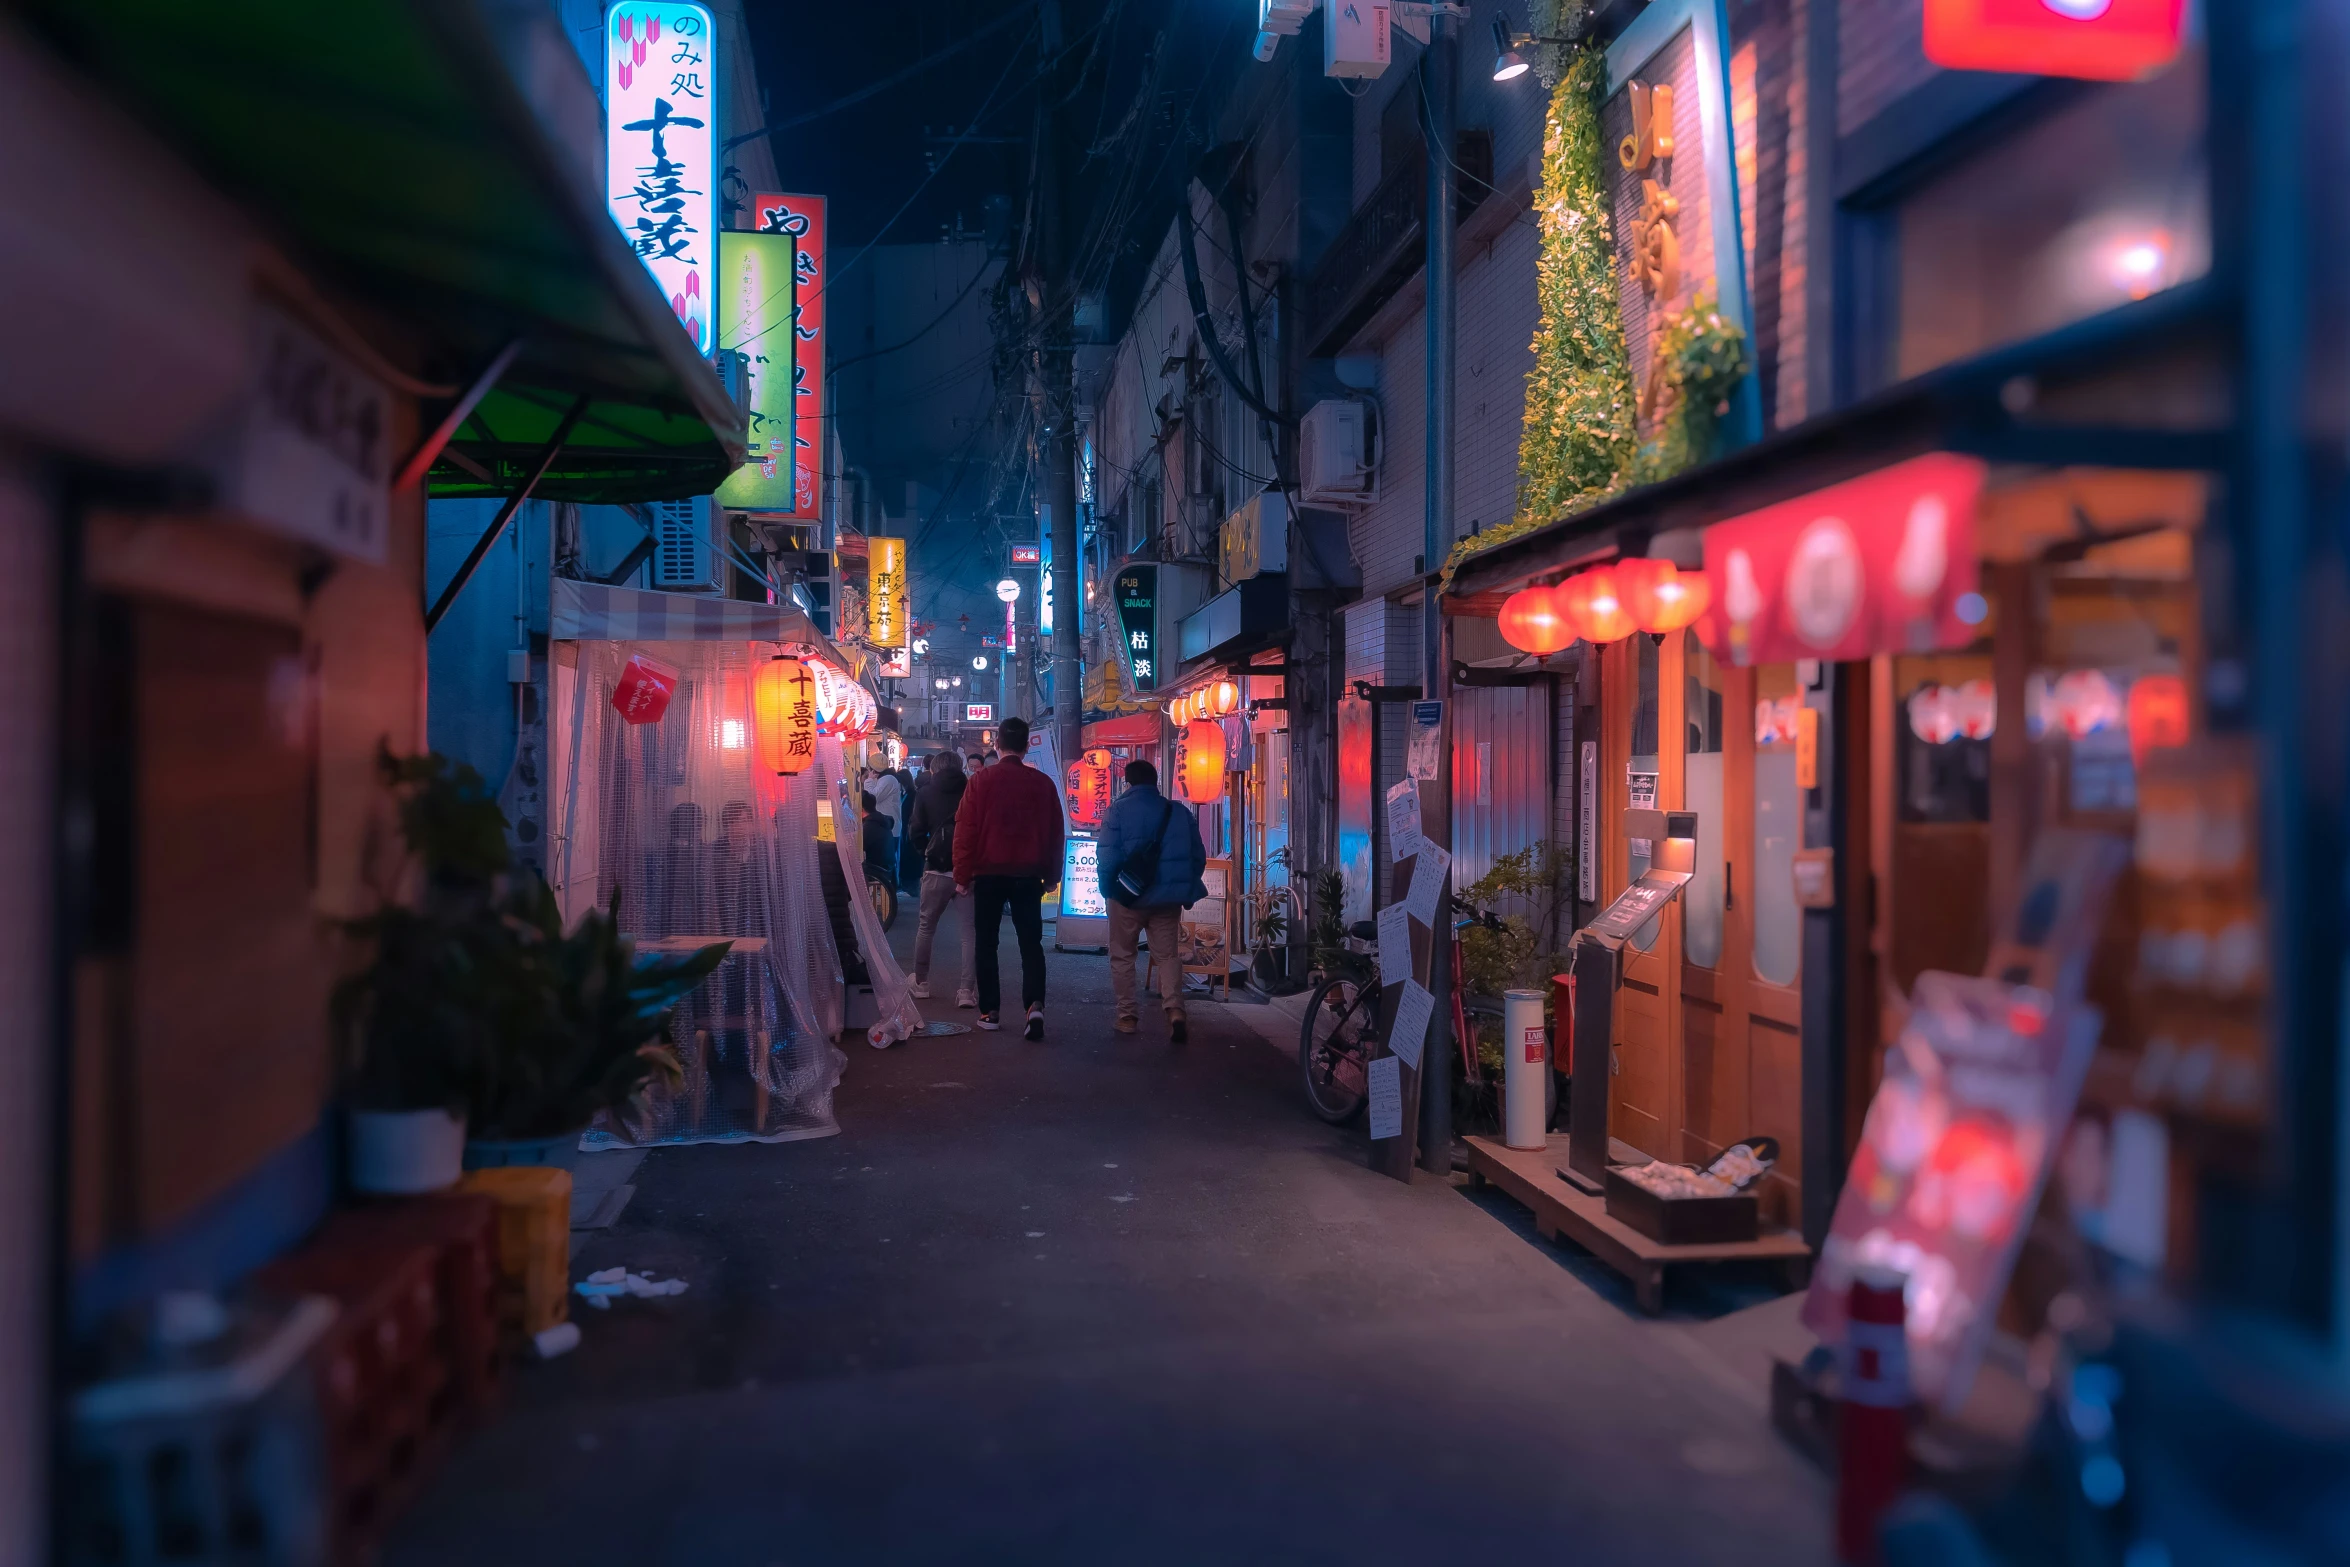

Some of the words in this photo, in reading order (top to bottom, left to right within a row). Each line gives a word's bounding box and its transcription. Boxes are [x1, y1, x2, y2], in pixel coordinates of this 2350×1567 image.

[670, 16, 705, 98] のみ処
[613, 97, 705, 265] 十喜蔵
[877, 571, 892, 627] 東京苑
[1121, 578, 1139, 588] PUB
[1124, 598, 1152, 608] SNACK
[1131, 631, 1152, 678] 枯淡
[816, 670, 834, 709] アサヒビール
[786, 669, 814, 758] 十喜蔵
[968, 705, 990, 719] 明
[1087, 906, 1107, 915] コタン
